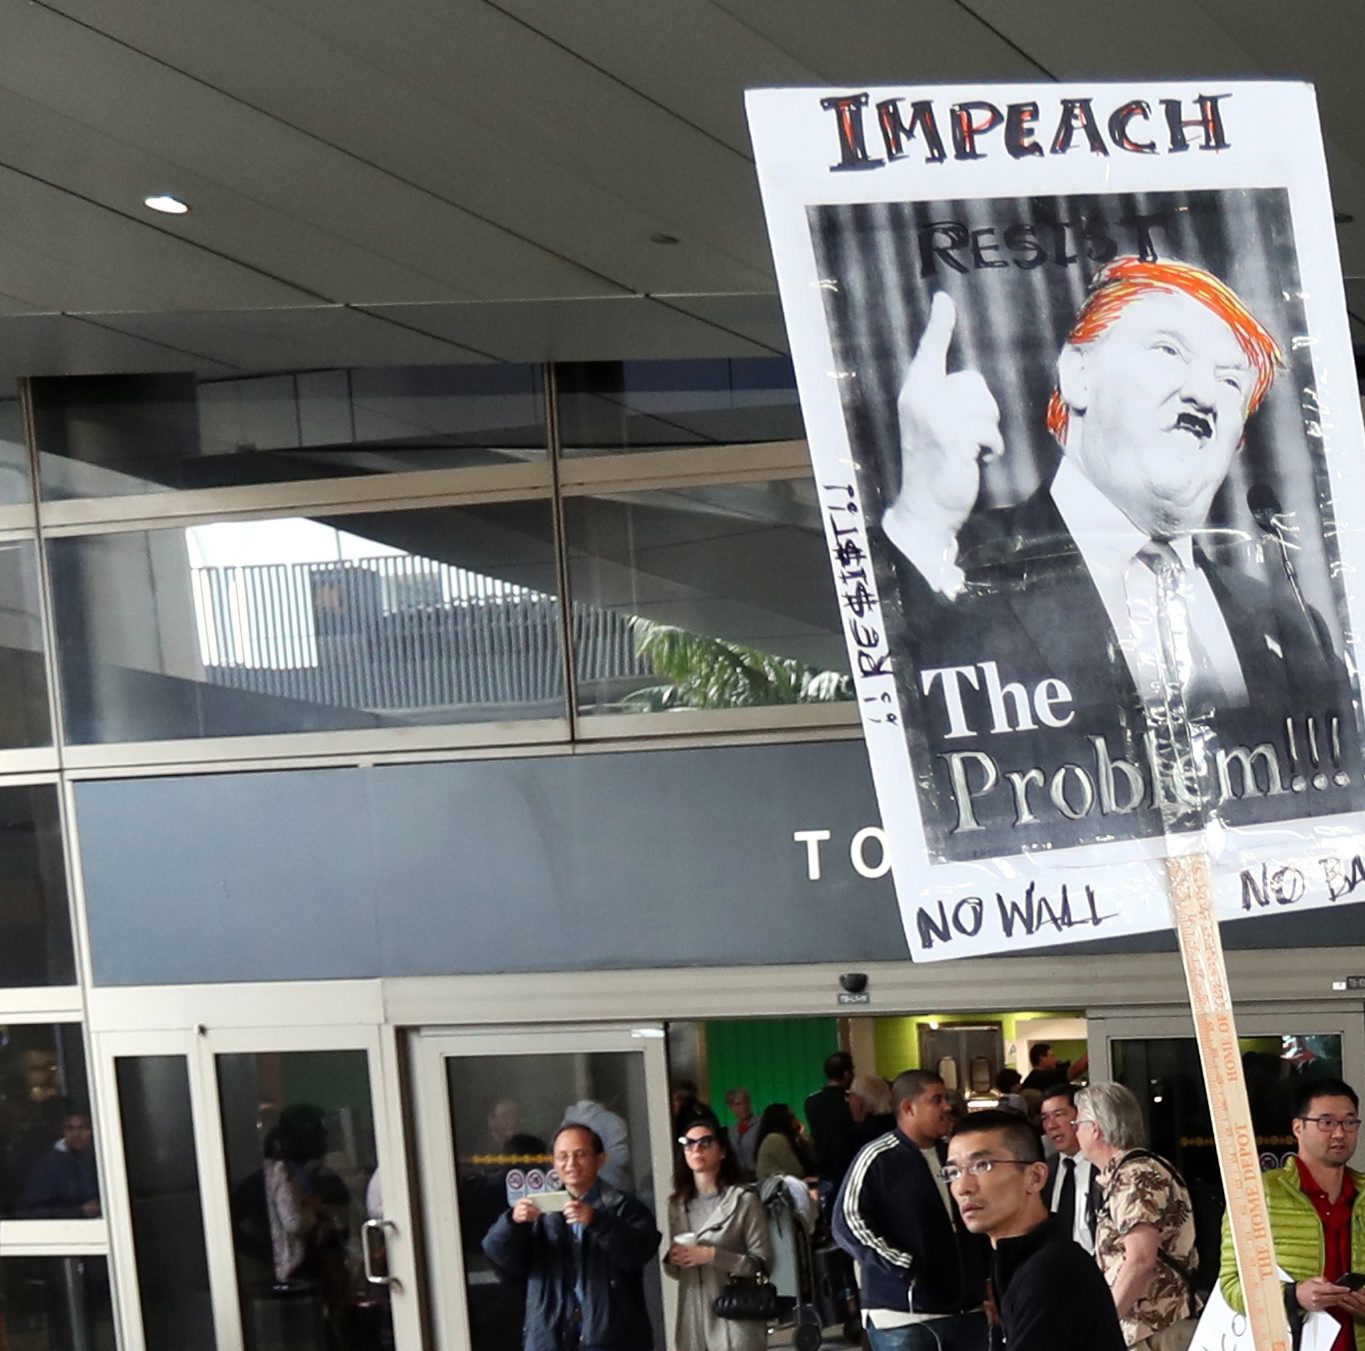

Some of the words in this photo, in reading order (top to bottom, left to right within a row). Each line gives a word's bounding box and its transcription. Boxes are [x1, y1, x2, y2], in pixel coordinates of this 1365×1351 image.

[820, 92, 1233, 172] IMPEACH
[919, 212, 1171, 279] RESIST
[921, 660, 1075, 739] The
[917, 896, 984, 951] NO
[995, 880, 1118, 938] WALL
[1239, 863, 1307, 911] NO
[1223, 1035, 1240, 1082] HOME
[1234, 1123, 1257, 1183] DEPOT
[1246, 1188, 1267, 1240] HOME
[1257, 1247, 1274, 1279] THE
